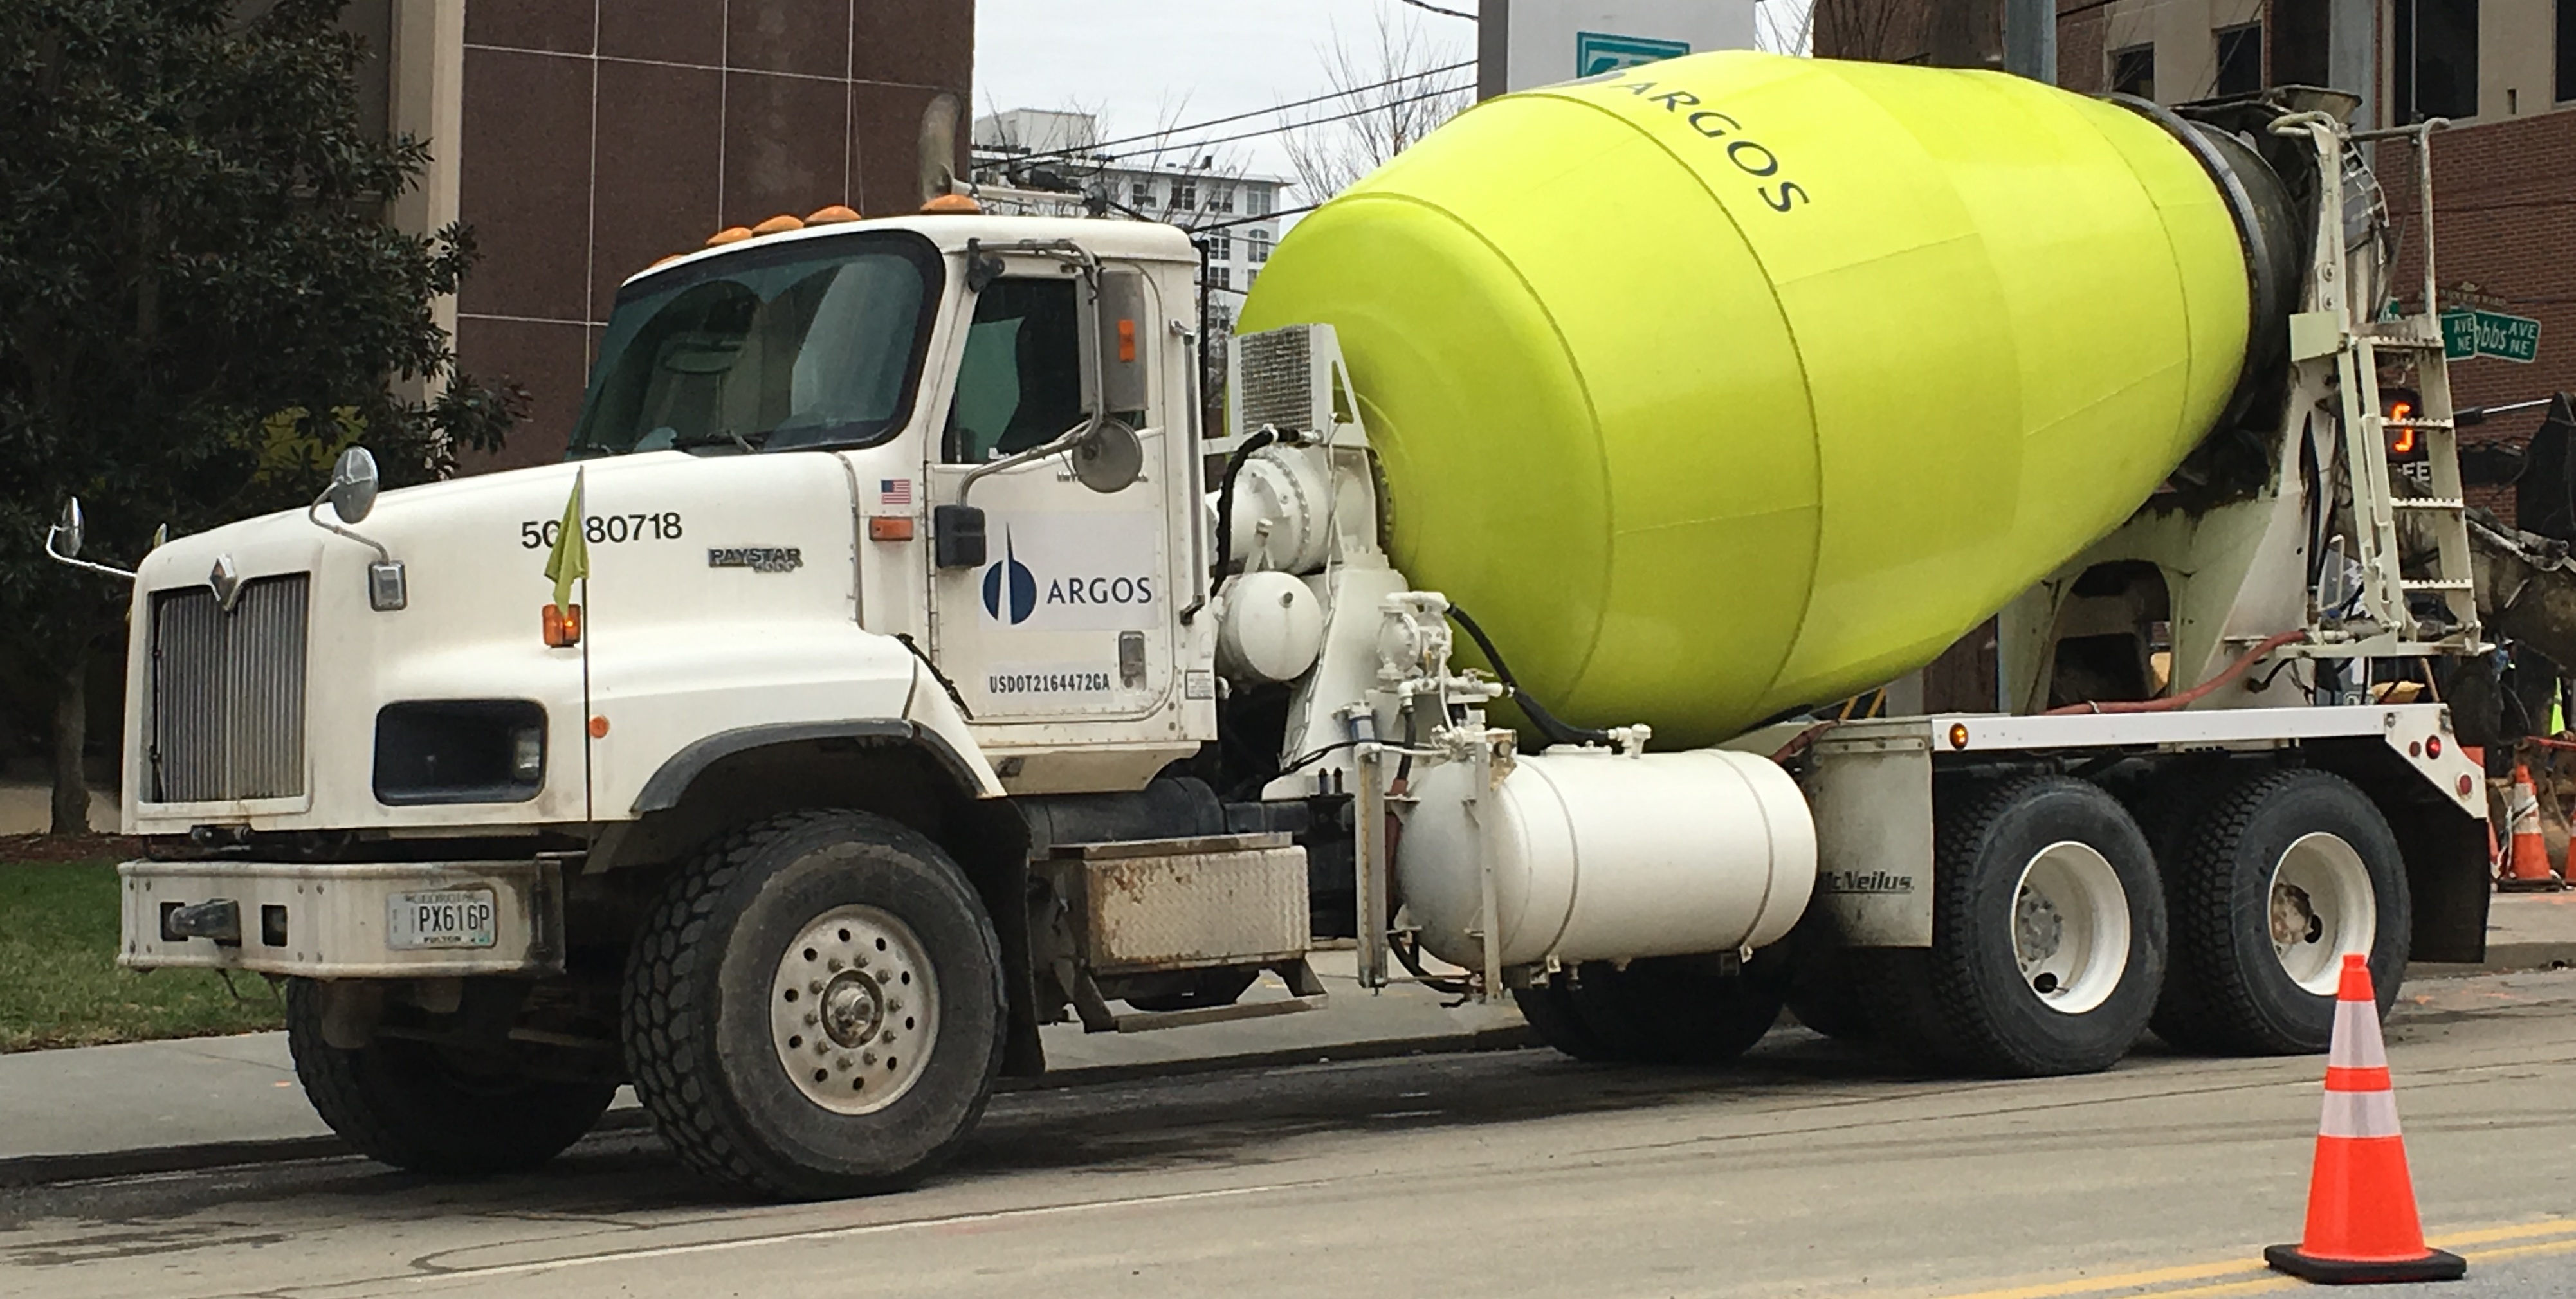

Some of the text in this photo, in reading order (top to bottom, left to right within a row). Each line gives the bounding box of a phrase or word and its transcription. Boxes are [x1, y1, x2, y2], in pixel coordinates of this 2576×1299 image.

[1608, 82, 1810, 213] ARGOS
[2454, 318, 2474, 334] AVE
[2508, 322, 2537, 340] AVE
[2458, 336, 2472, 351] NE
[2510, 339, 2531, 356] NE
[709, 548, 802, 566] PAYSTAR
[1047, 577, 1152, 604] ARGOS
[989, 673, 1110, 693] USDOT2164472GA
[419, 904, 490, 932] PX616P
